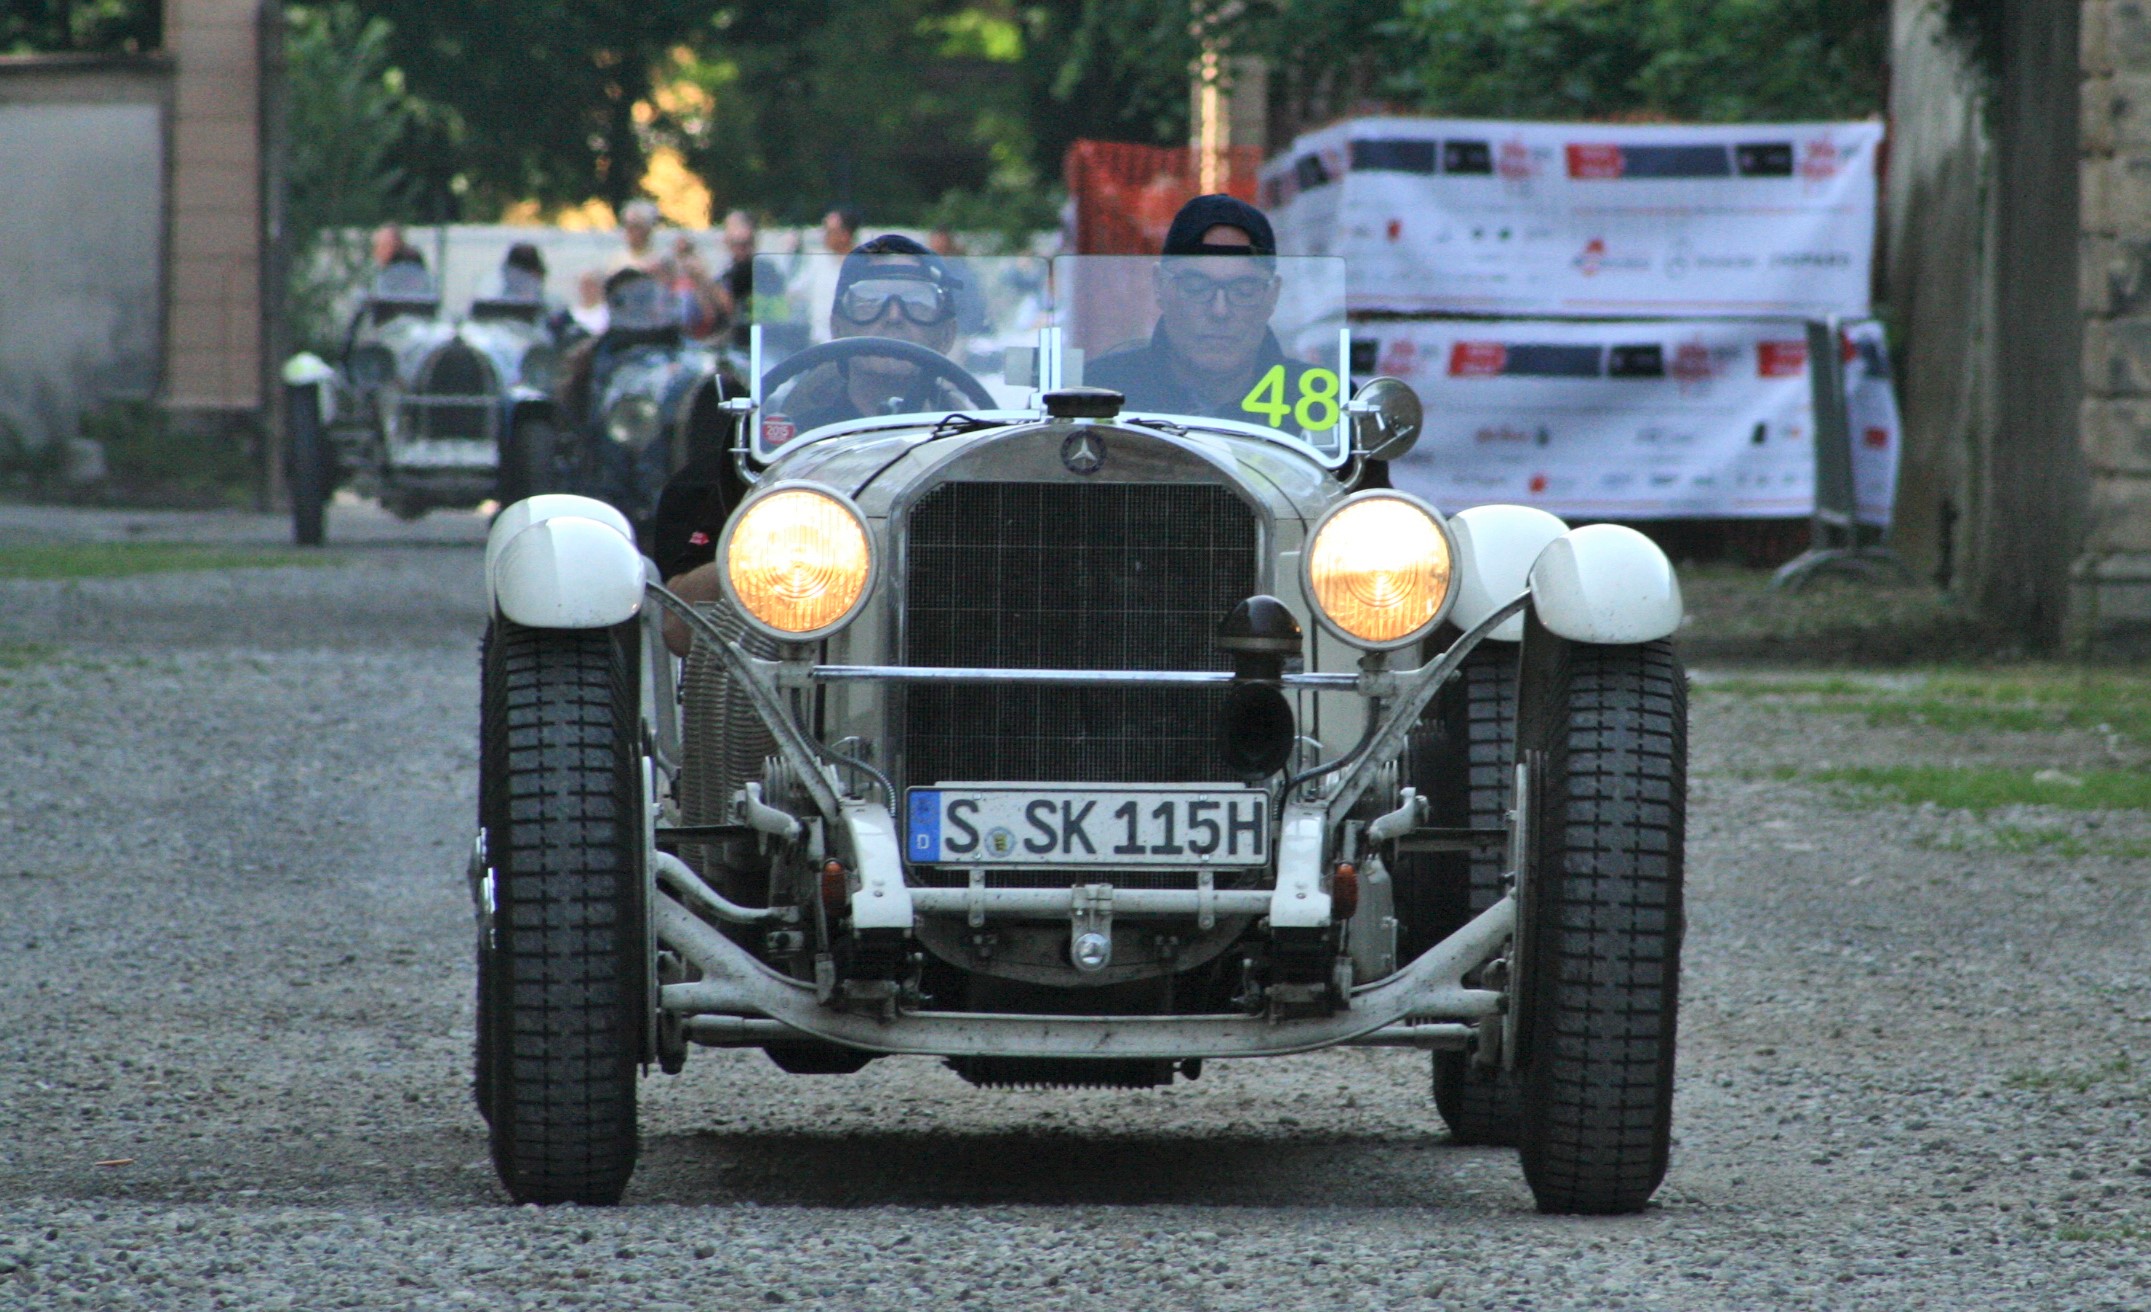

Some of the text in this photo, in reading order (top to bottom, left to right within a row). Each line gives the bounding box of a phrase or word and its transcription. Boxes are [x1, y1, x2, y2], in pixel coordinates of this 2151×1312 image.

[1241, 364, 1339, 431] 48
[917, 834, 930, 849] D
[945, 799, 979, 853] S
[1023, 799, 1096, 855] SK
[1113, 800, 1262, 855] 115H
